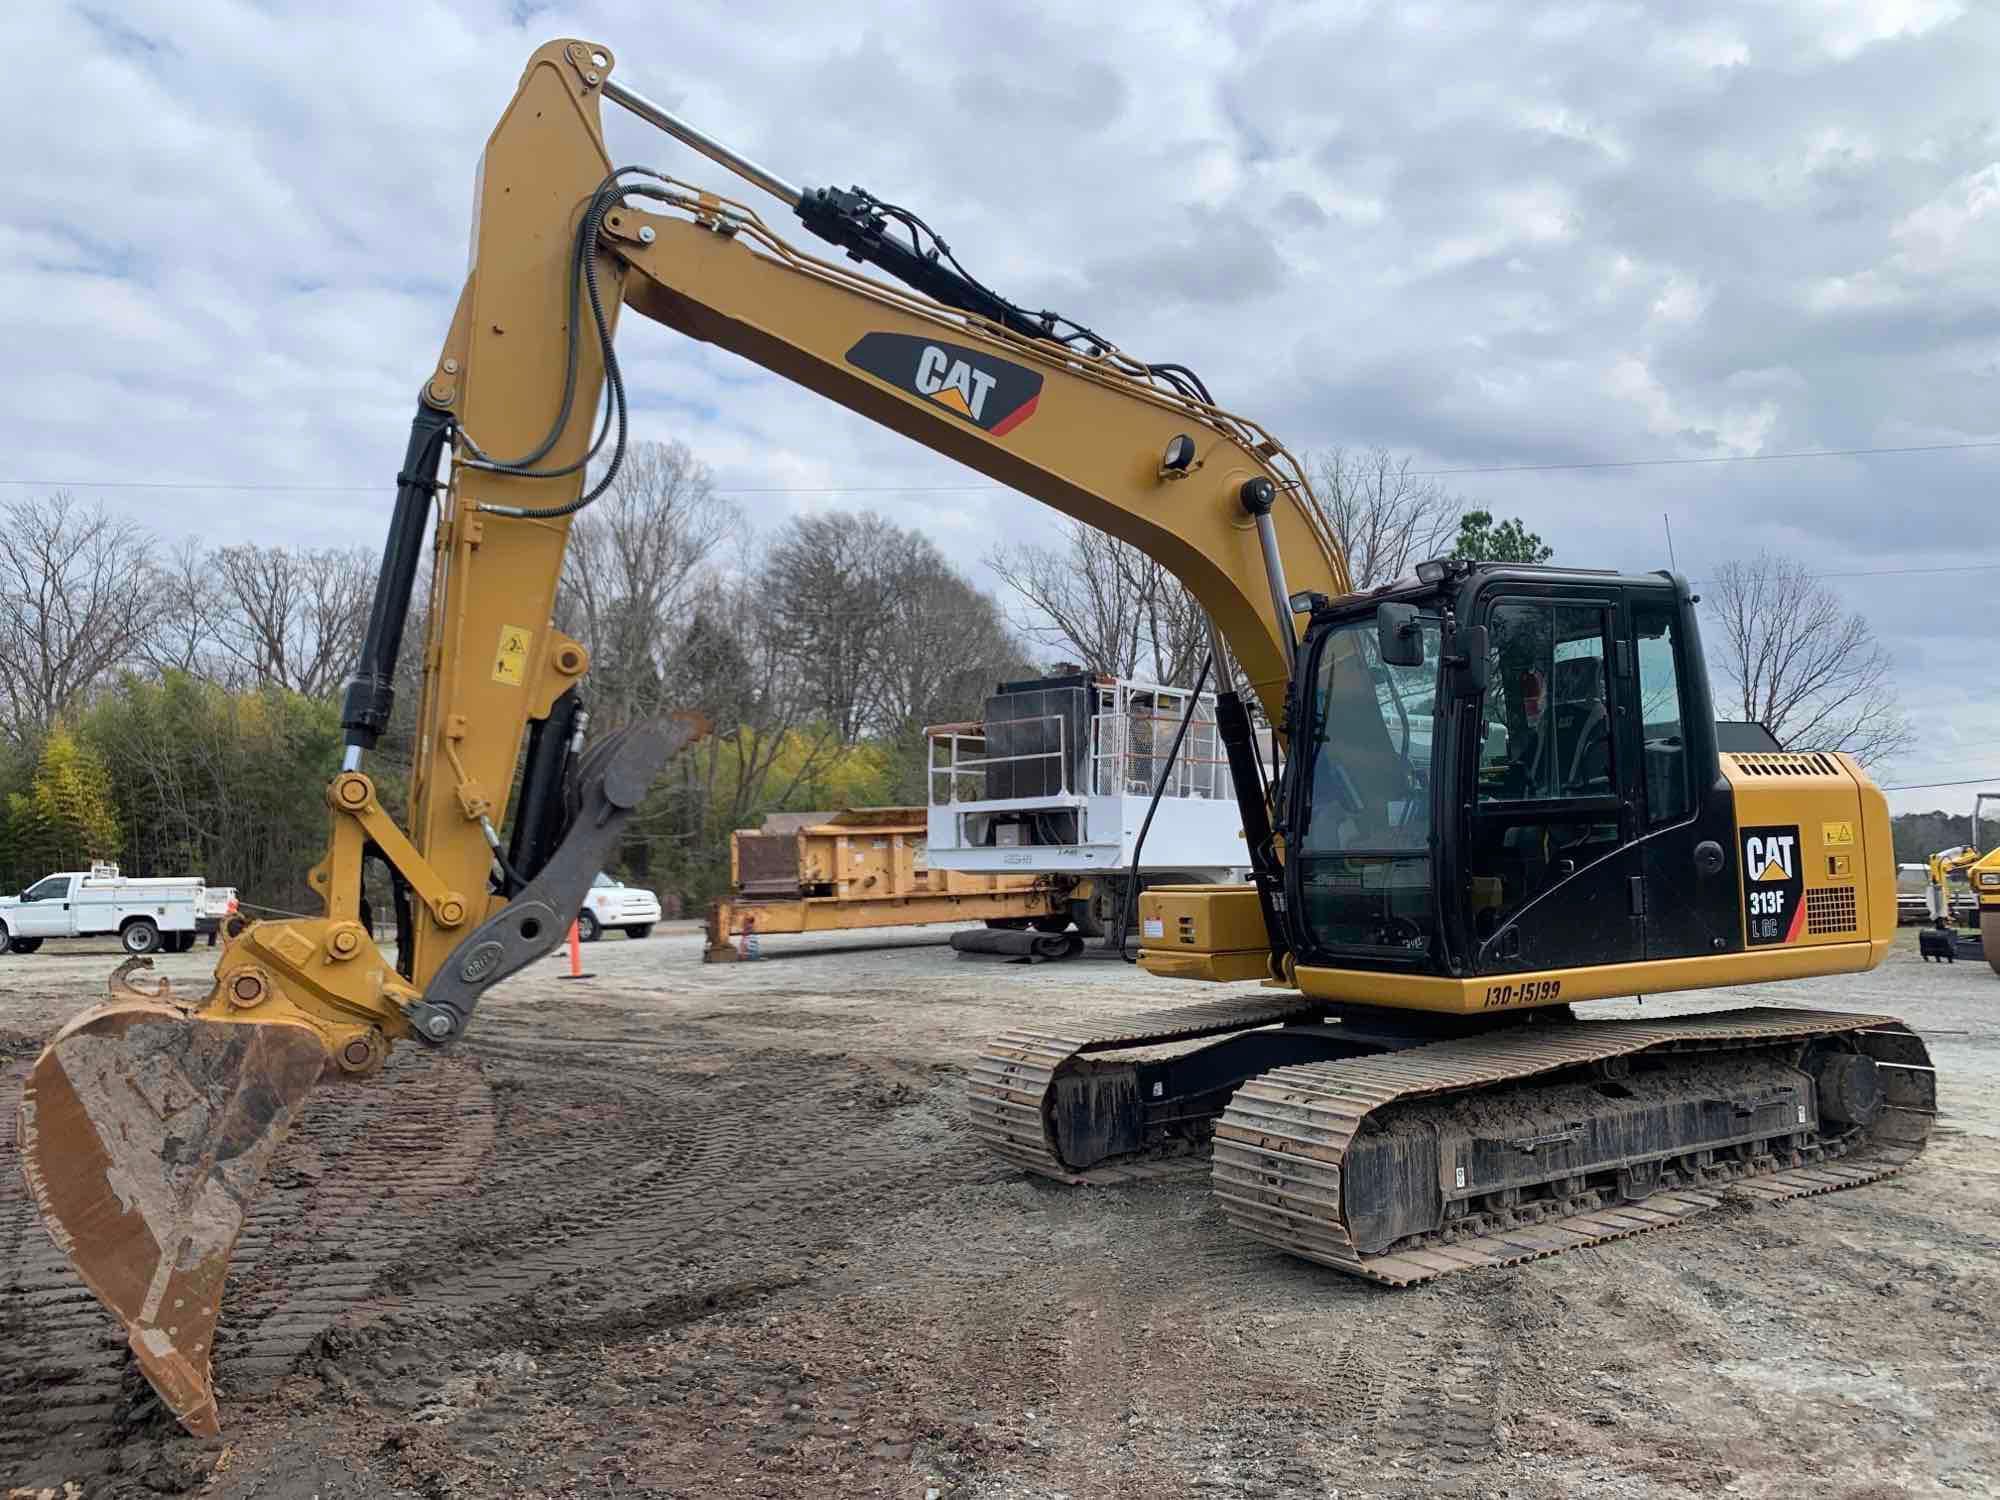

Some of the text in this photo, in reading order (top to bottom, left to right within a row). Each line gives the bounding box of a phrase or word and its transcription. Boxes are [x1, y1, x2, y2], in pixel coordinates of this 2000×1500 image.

[914, 344, 997, 421] CAT
[1746, 835, 1795, 882] CAT
[1750, 889, 1785, 915] 313F
[1484, 980, 1561, 1009] 130-15199
